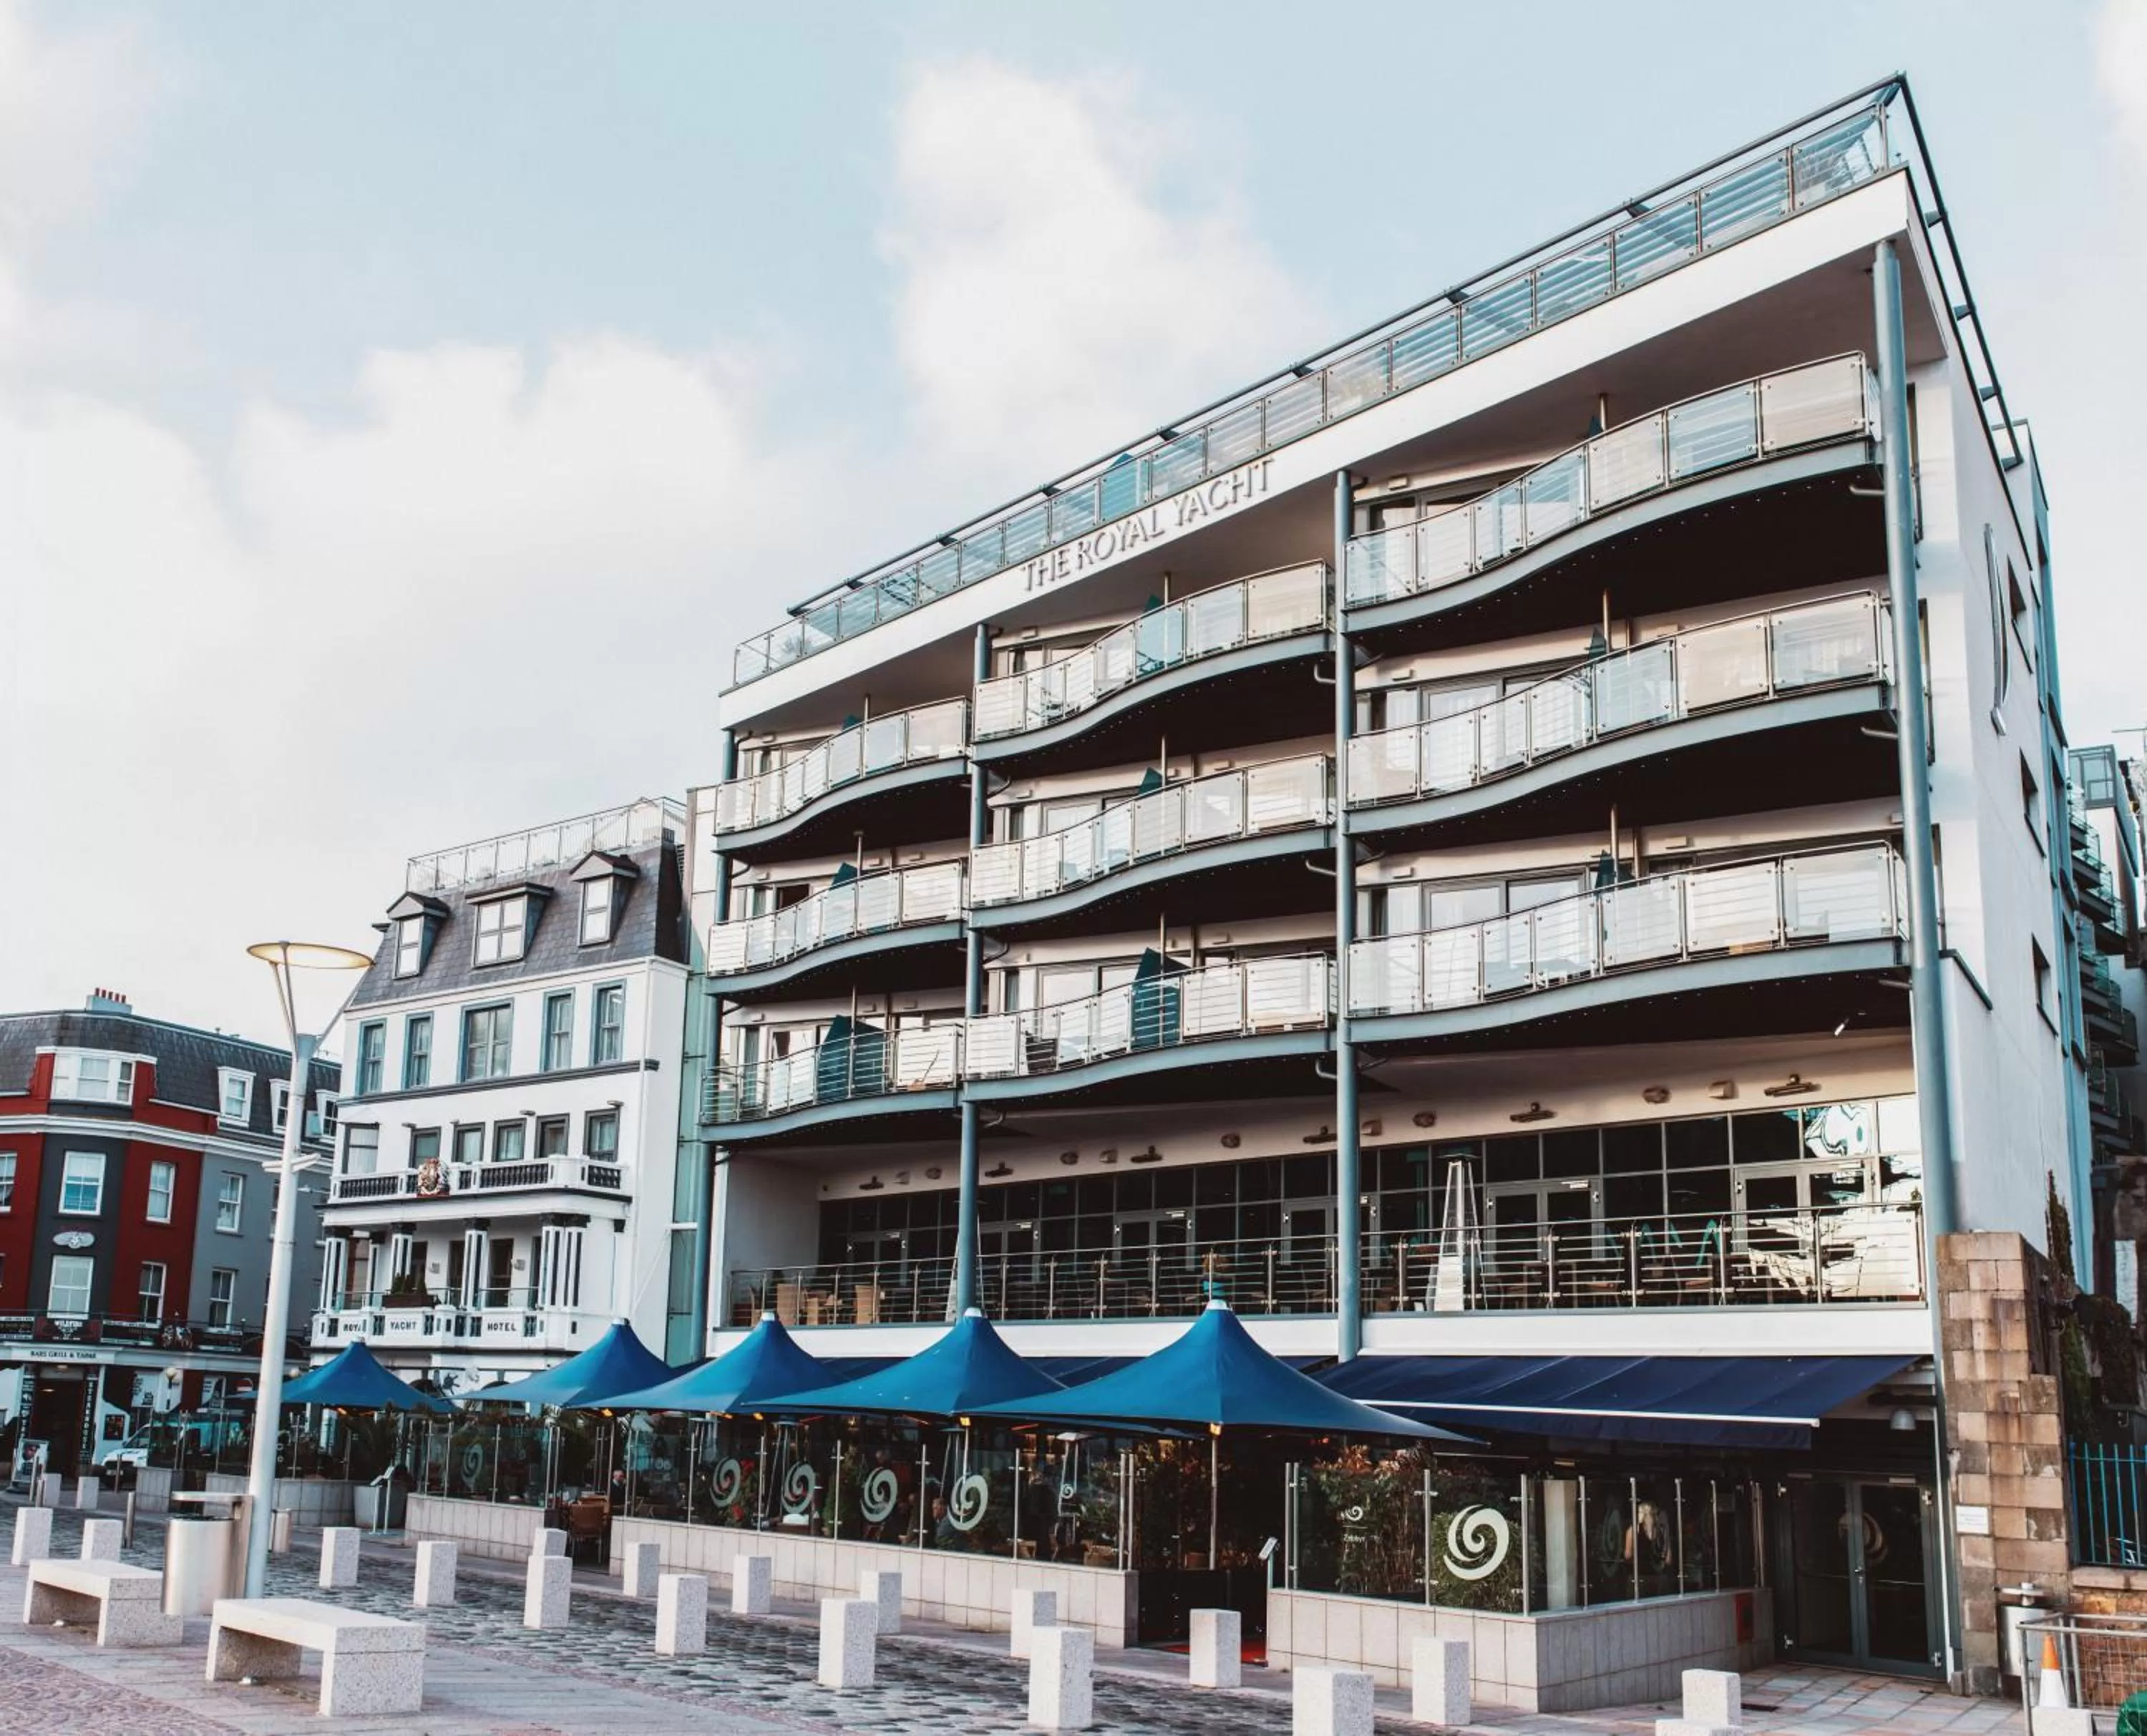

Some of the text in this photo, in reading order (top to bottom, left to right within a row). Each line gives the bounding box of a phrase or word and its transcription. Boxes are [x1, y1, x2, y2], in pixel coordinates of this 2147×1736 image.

[1021, 457, 1276, 593] THE ROYAL YACHT
[344, 1321, 517, 1332] ROY YACHT HOTEL
